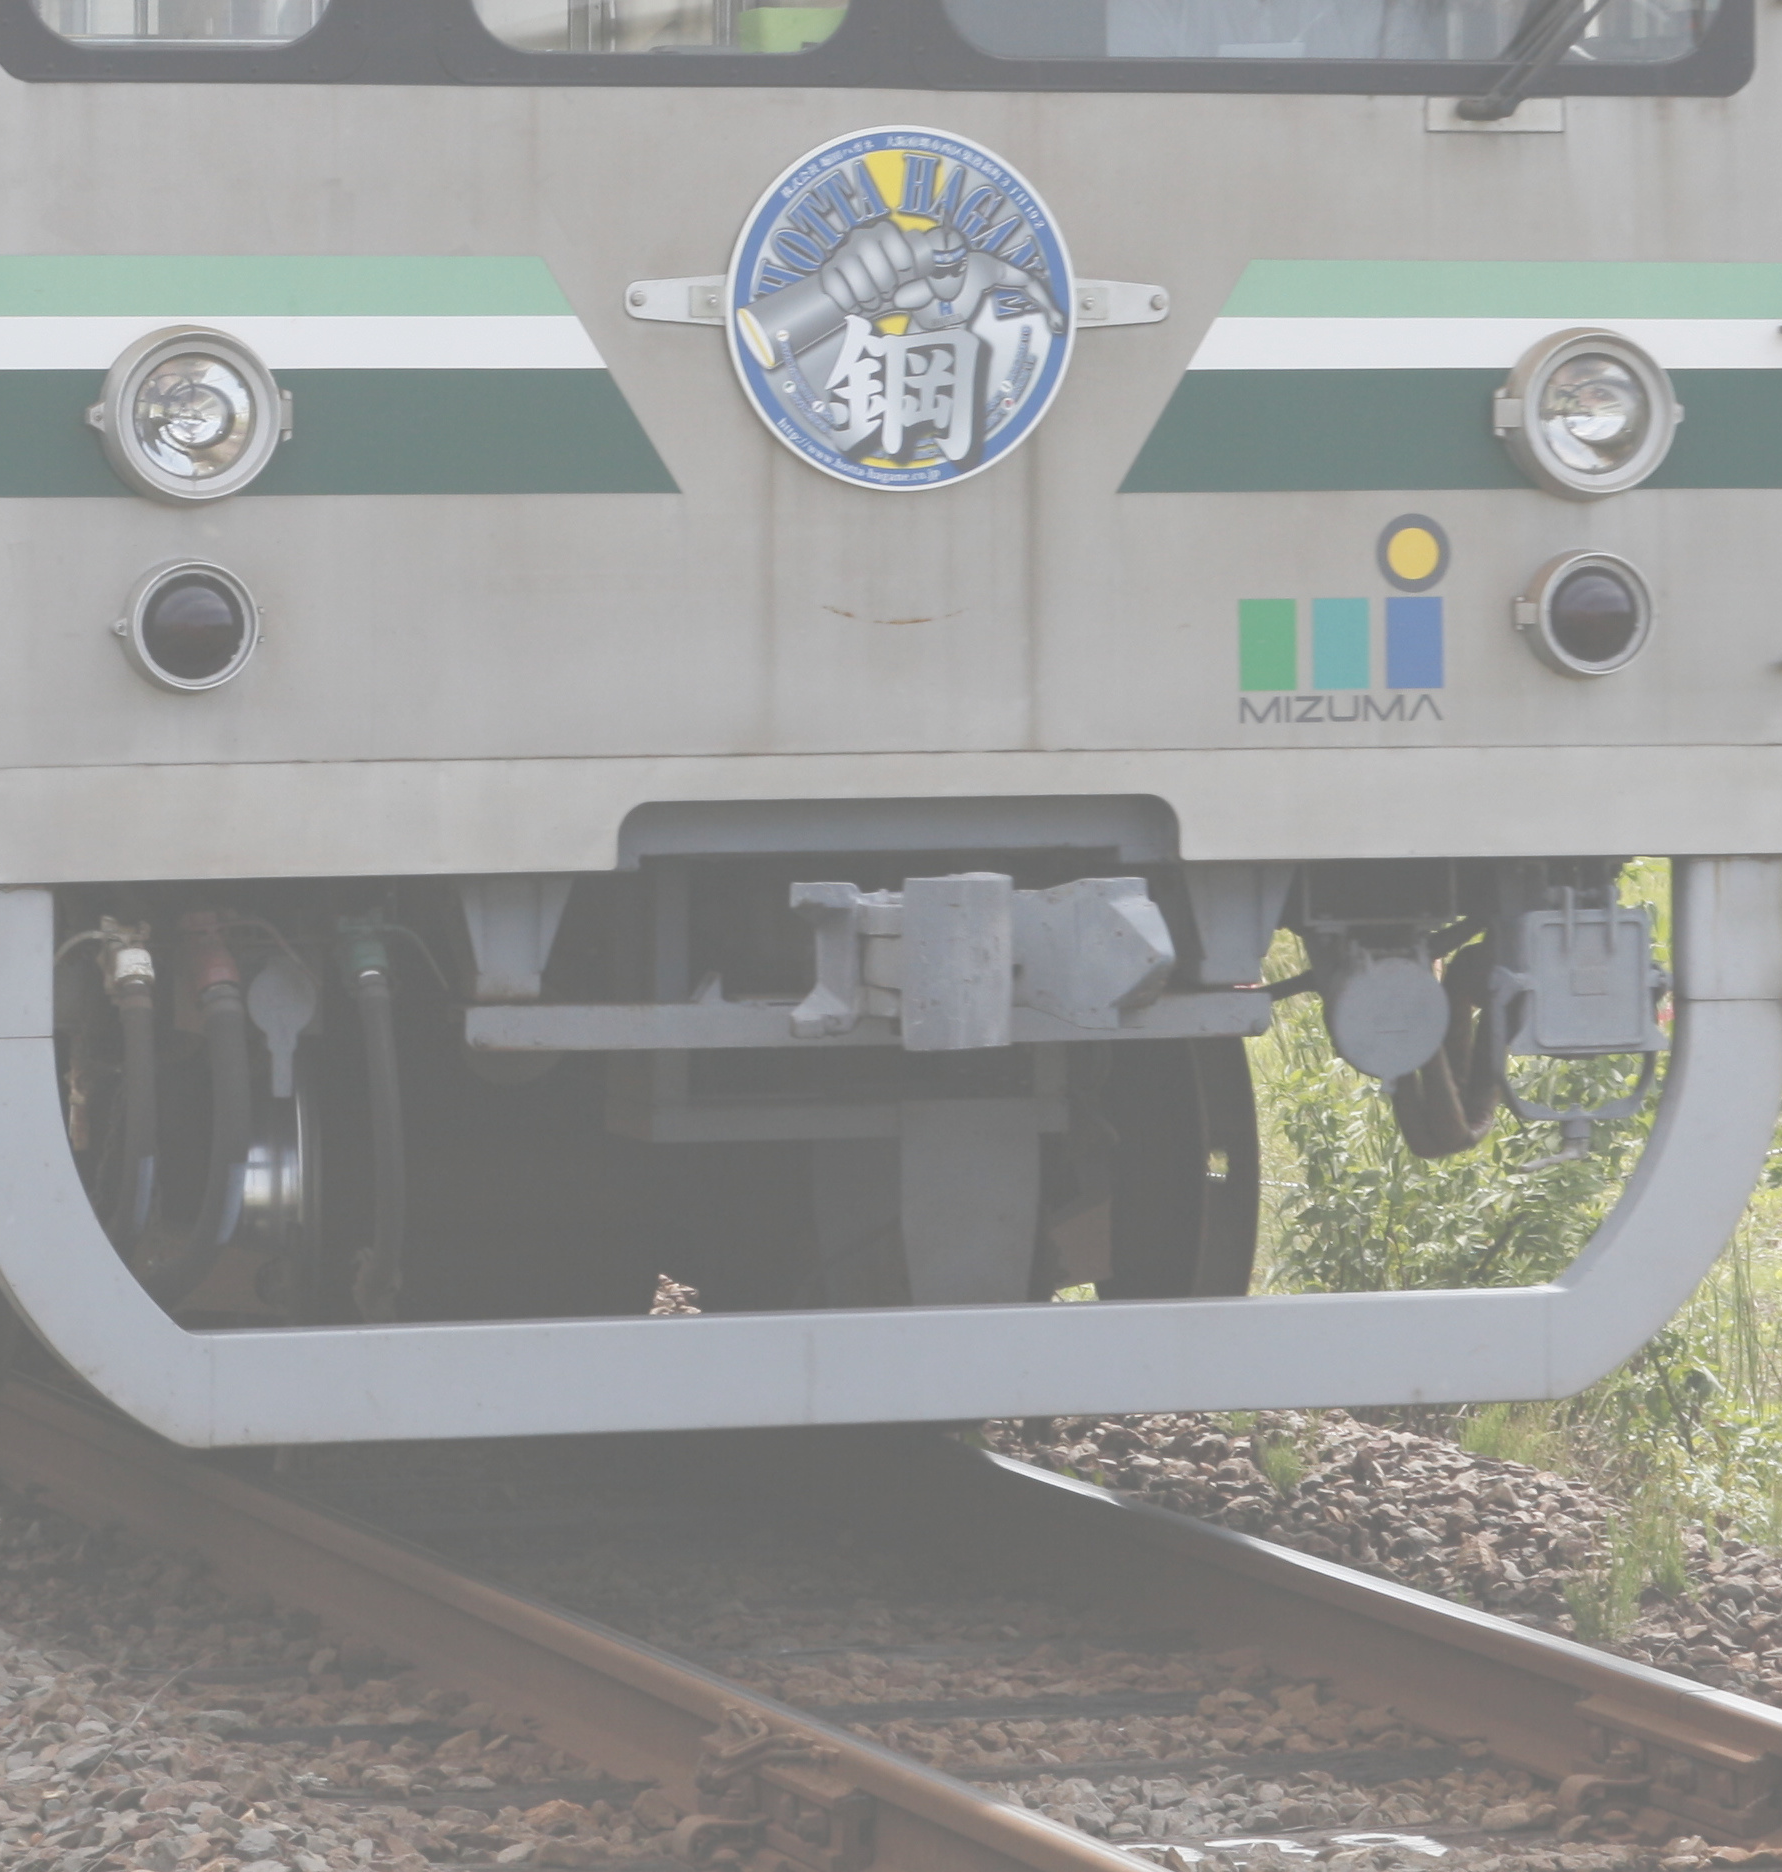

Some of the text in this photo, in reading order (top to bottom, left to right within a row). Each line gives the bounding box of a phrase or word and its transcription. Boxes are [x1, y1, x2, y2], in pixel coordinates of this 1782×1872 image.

[750, 161, 889, 301] HOTTA
[825, 314, 980, 461] 鋼
[1239, 694, 1443, 723] MIZUMA
